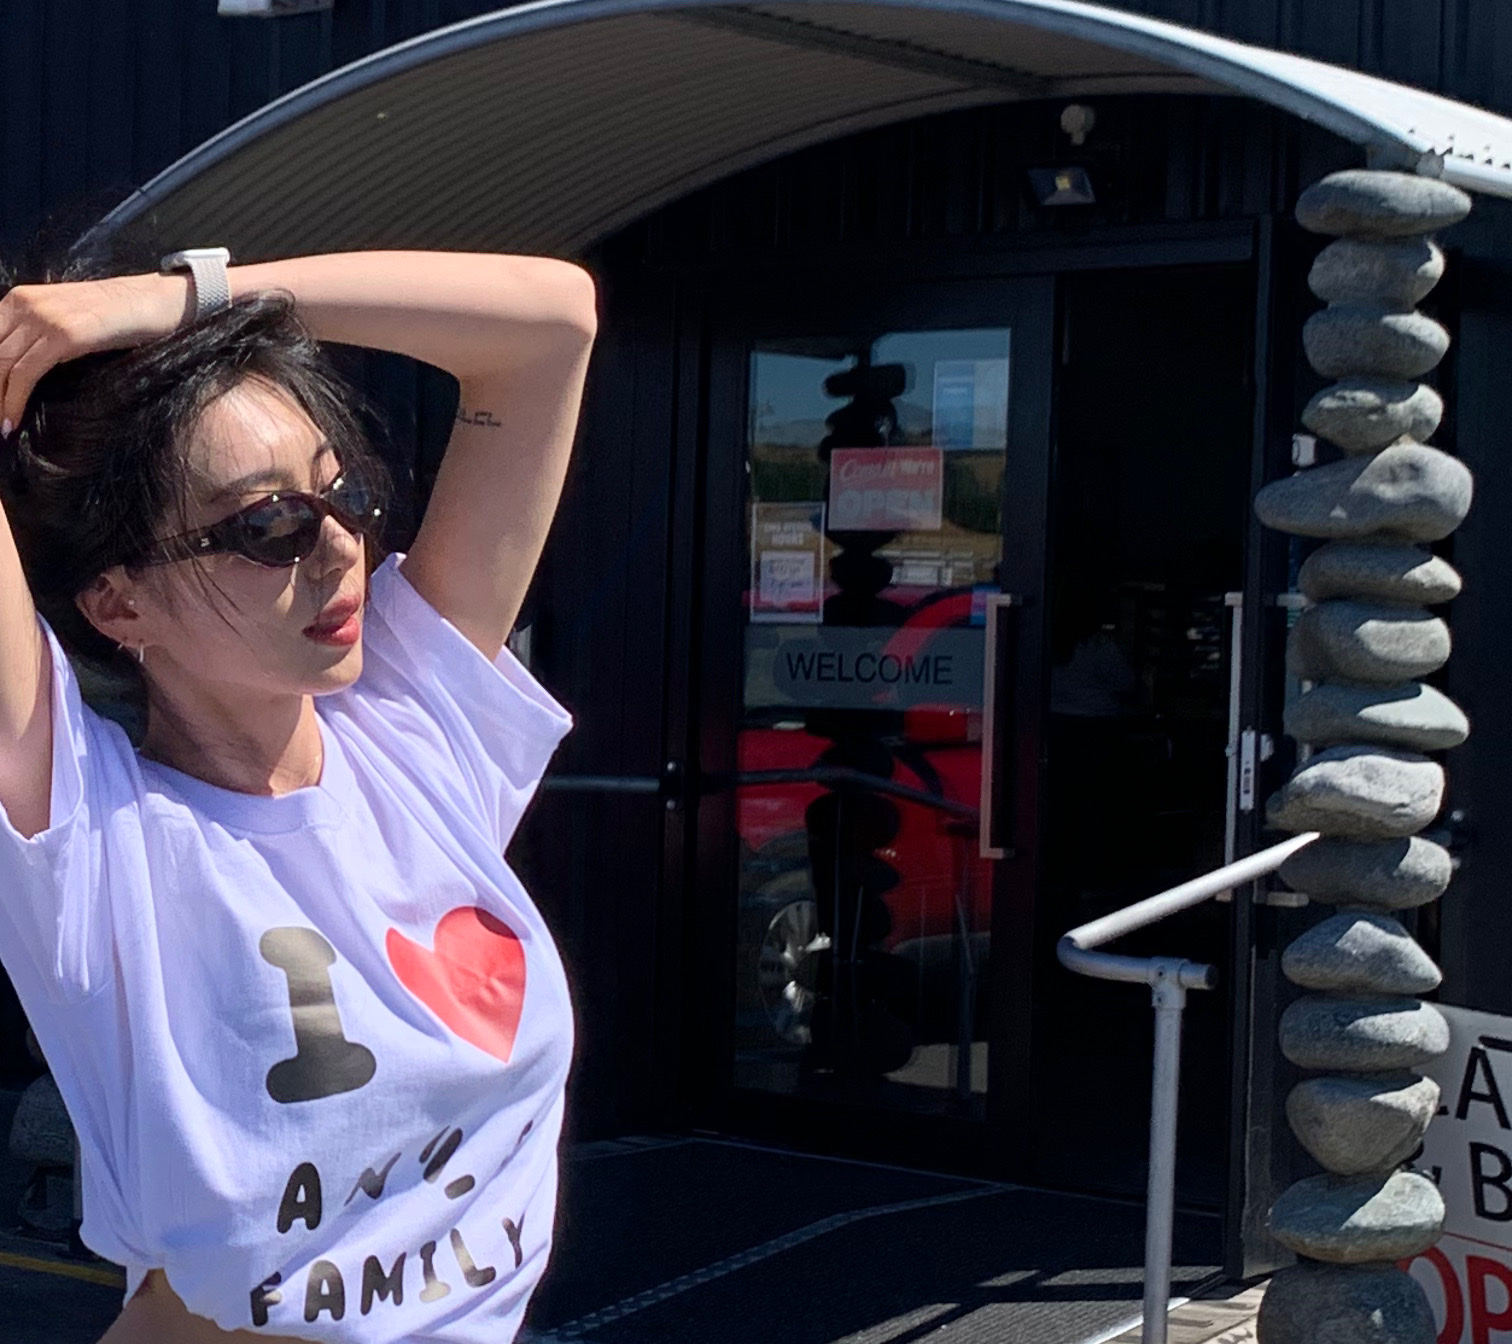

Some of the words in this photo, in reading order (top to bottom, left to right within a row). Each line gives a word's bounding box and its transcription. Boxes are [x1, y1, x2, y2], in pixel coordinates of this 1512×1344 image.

[838, 489, 935, 525] OPEN
[786, 652, 954, 685] WELCOME
[259, 926, 377, 1105] I
[250, 1211, 526, 1327] FAMILY
